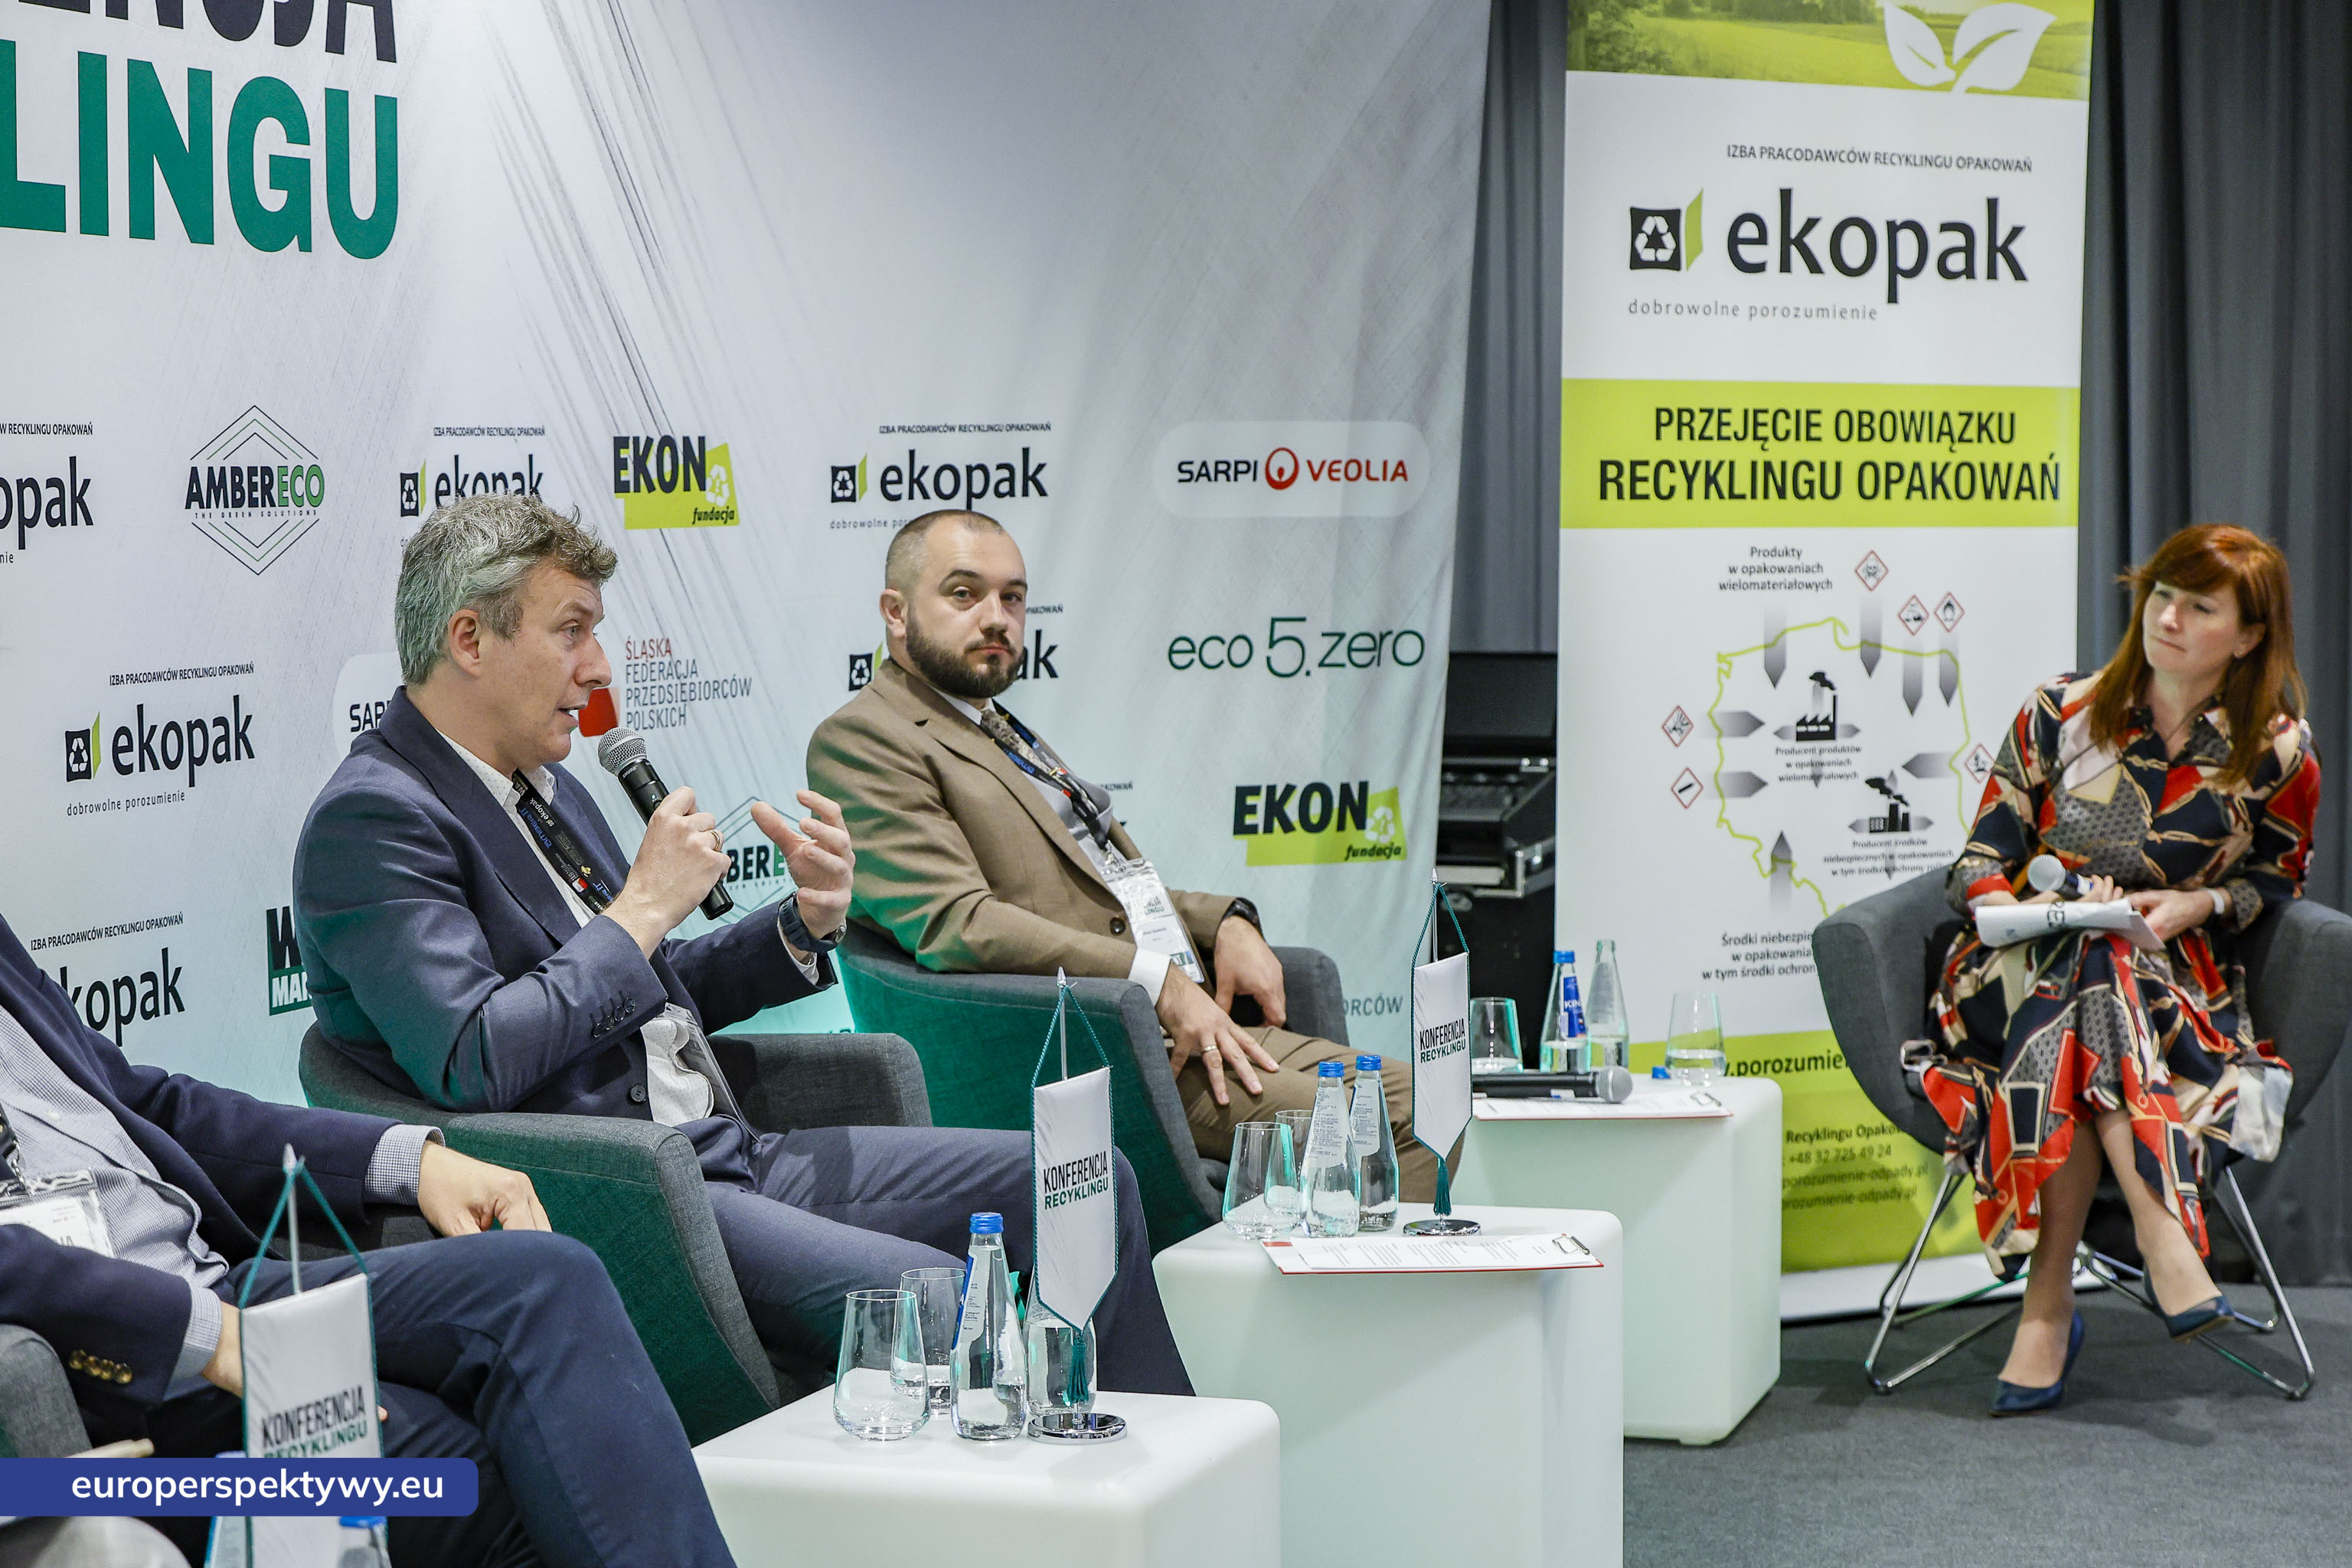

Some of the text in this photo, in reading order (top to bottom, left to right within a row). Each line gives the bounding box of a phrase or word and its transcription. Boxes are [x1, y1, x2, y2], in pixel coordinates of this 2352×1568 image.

[0, 40, 397, 259] LINGU
[1727, 145, 2033, 172] IZBA PRACODAWCÓW RECYKLINGU OPAKOWAŃ
[1727, 188, 2029, 304] ekopak
[1629, 299, 1877, 321] dobrowolne porozumienie
[8, 423, 51, 436] RECYKLINGU
[53, 421, 93, 436] OPAKOWAŃ
[959, 424, 1004, 433] RECYKLINGU
[1655, 407, 2017, 452] PRZEJĘCIE OBOWIĄZKU
[613, 436, 707, 494] EKON
[1177, 459, 1409, 483] SARPI VEOLIA
[1599, 452, 2060, 501] RECYKLINGU OPAKOWAŃ
[185, 464, 325, 510] AMBERECO
[880, 447, 1049, 511] ekopak
[692, 508, 735, 525] fundacja
[1750, 546, 1803, 561] Produkty
[1729, 561, 1823, 577] w opakowaniach
[1719, 578, 1833, 592] wielomateriałowych
[626, 636, 671, 663] ŚLĄSKA
[1168, 635, 1253, 670] eco
[109, 661, 254, 686] IZBA PRACODAWCÓW RECYKLINGU OPAKOWAŃ
[626, 658, 698, 684] FEDERACJA
[626, 674, 752, 708] PRZEDSIĘBIORCÓW
[626, 704, 687, 731] POLSKICH
[112, 694, 255, 788] ekopak
[67, 789, 185, 816] dobrowolne porozumienie
[1233, 781, 1369, 836] EKON
[1345, 843, 1402, 861] fundacja
[31, 911, 184, 952] IZBA PRACODAWCÓW RECYKLINGU OPAKOWAŃ
[1722, 930, 1758, 947] Środki
[1745, 947, 1812, 964] opakowania
[1702, 962, 1816, 981] w tym środki ochron
[1419, 1018, 1465, 1051] KONFERENCJA
[1420, 1038, 1466, 1063] RECYKLINGU
[1044, 1151, 1108, 1194] KONFERENCJA
[1044, 1176, 1109, 1210] RECYKLINGU
[262, 1386, 366, 1448] KONFERENCJA
